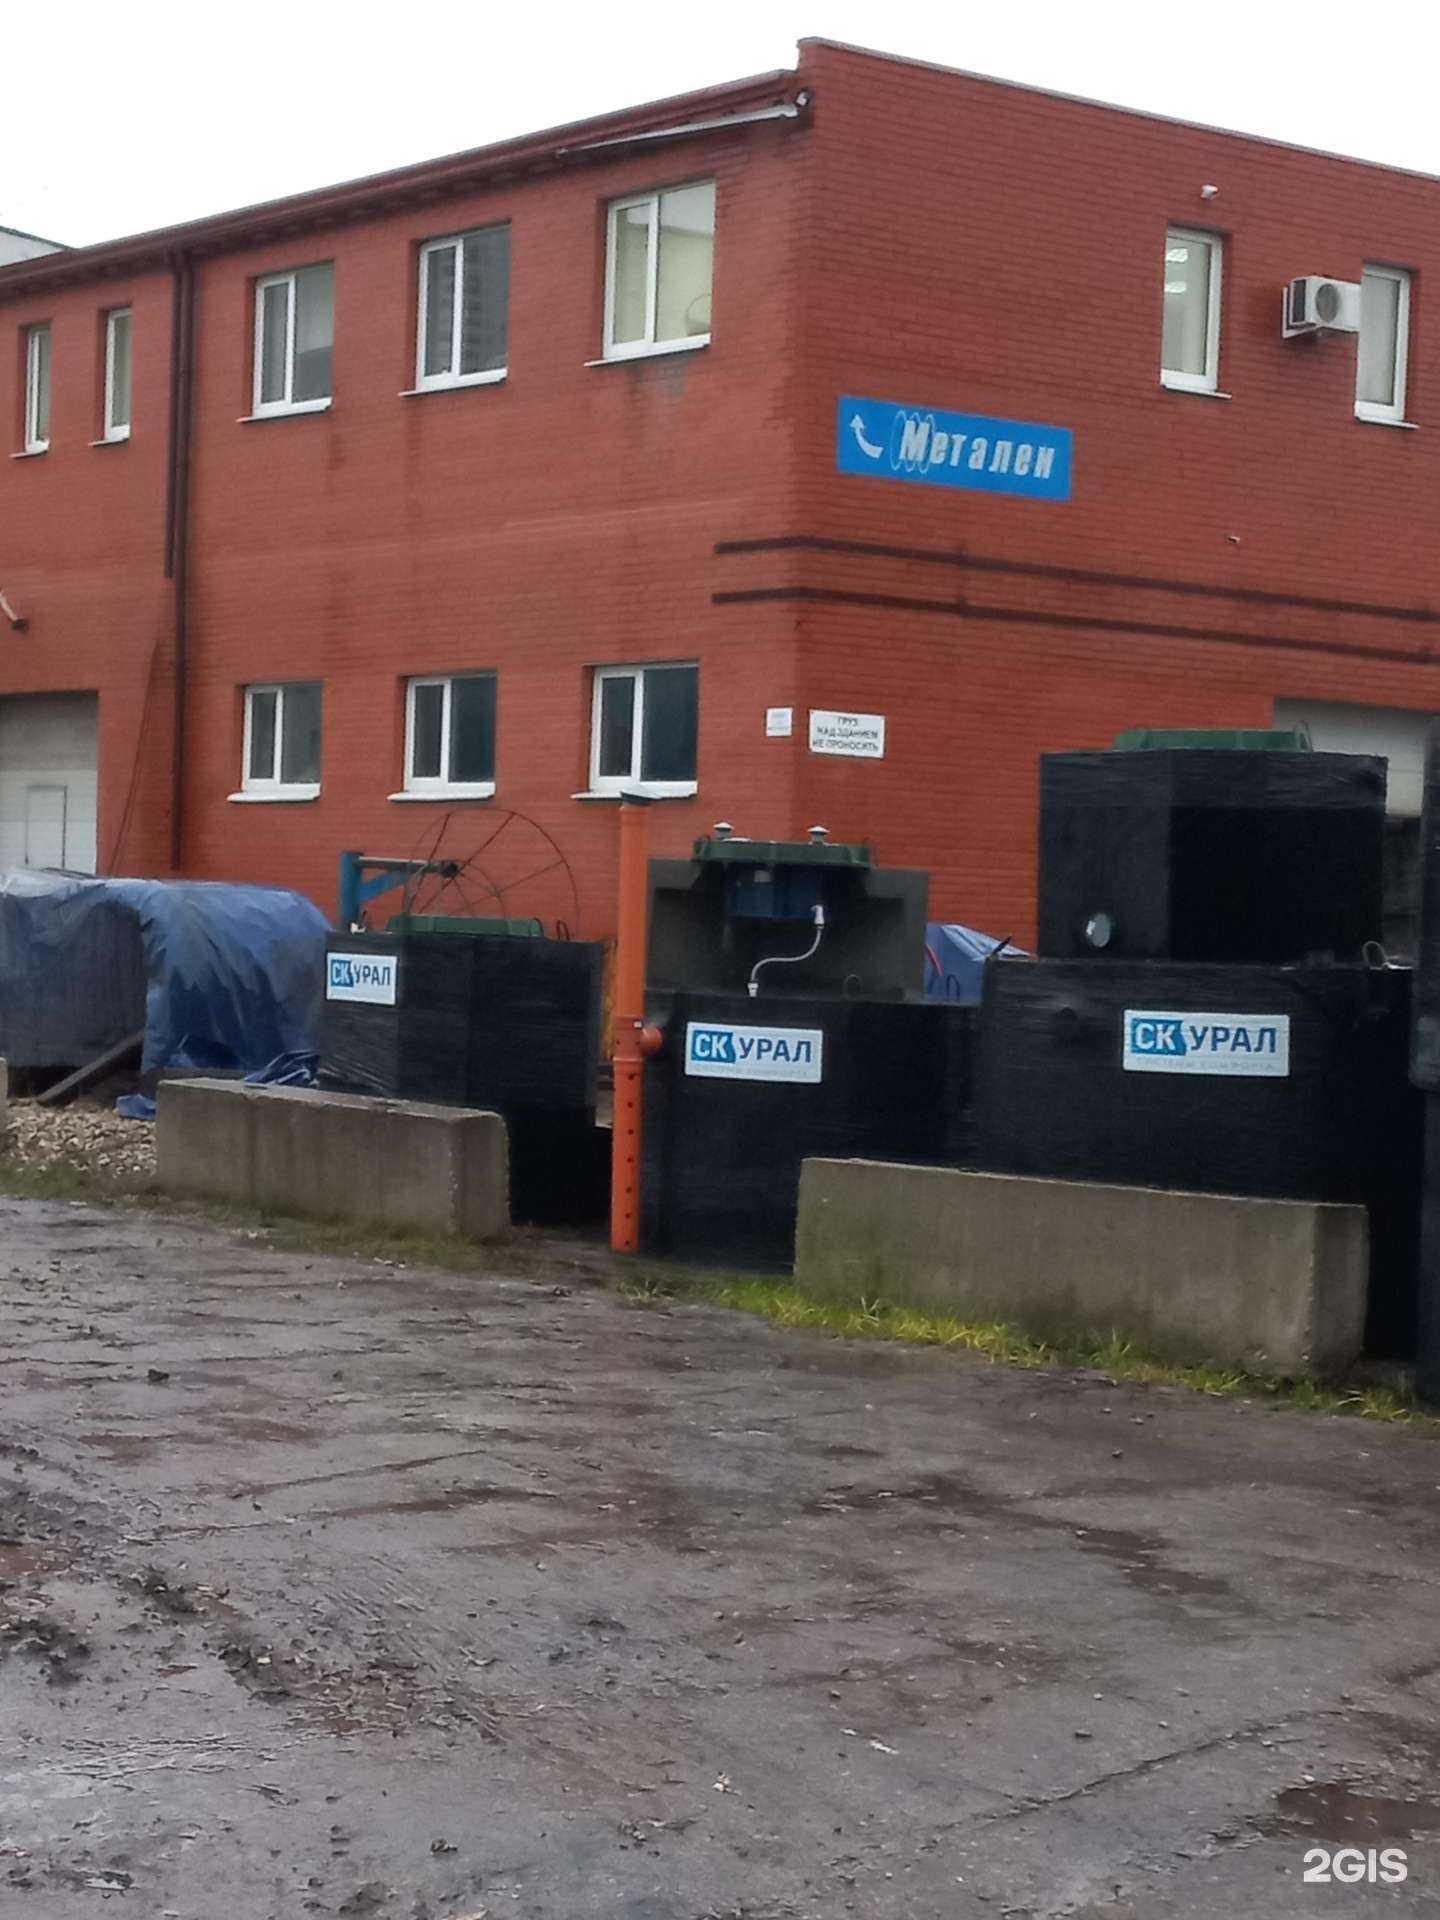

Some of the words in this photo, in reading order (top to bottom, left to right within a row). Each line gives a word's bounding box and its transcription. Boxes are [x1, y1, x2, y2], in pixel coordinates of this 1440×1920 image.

[898, 420, 1056, 479] Метален
[817, 726, 836, 737] НАД
[838, 716, 858, 727] ГРУЗ
[813, 738, 825, 749] НЕ
[826, 739, 879, 751] ПРОНОСИТЬ
[331, 961, 351, 984] СК
[354, 963, 392, 986] УРАЛ
[694, 1033, 728, 1059] СК
[738, 1037, 813, 1063] УРАЛ
[1135, 1022, 1177, 1051] СК
[1189, 1025, 1277, 1053] УРАЛ
